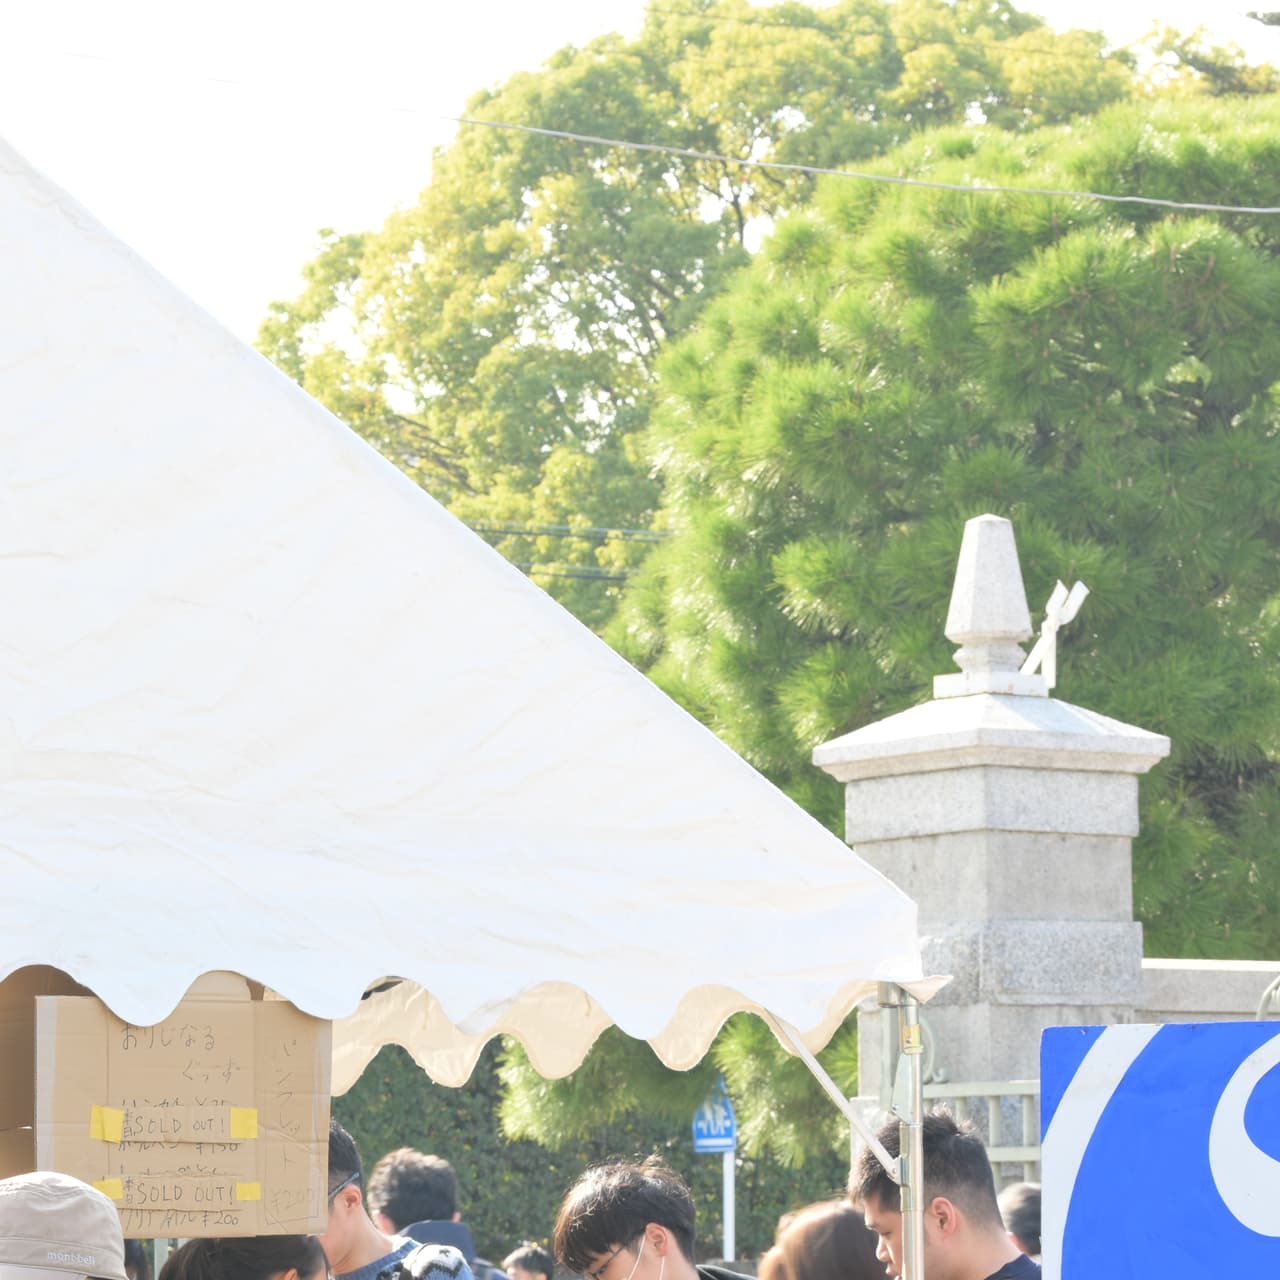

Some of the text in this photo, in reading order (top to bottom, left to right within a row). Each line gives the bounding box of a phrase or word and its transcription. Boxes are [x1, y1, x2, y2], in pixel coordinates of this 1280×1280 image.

[135, 1115, 182, 1135] SOLD
[136, 1182, 234, 1206] SOLD OUT!
